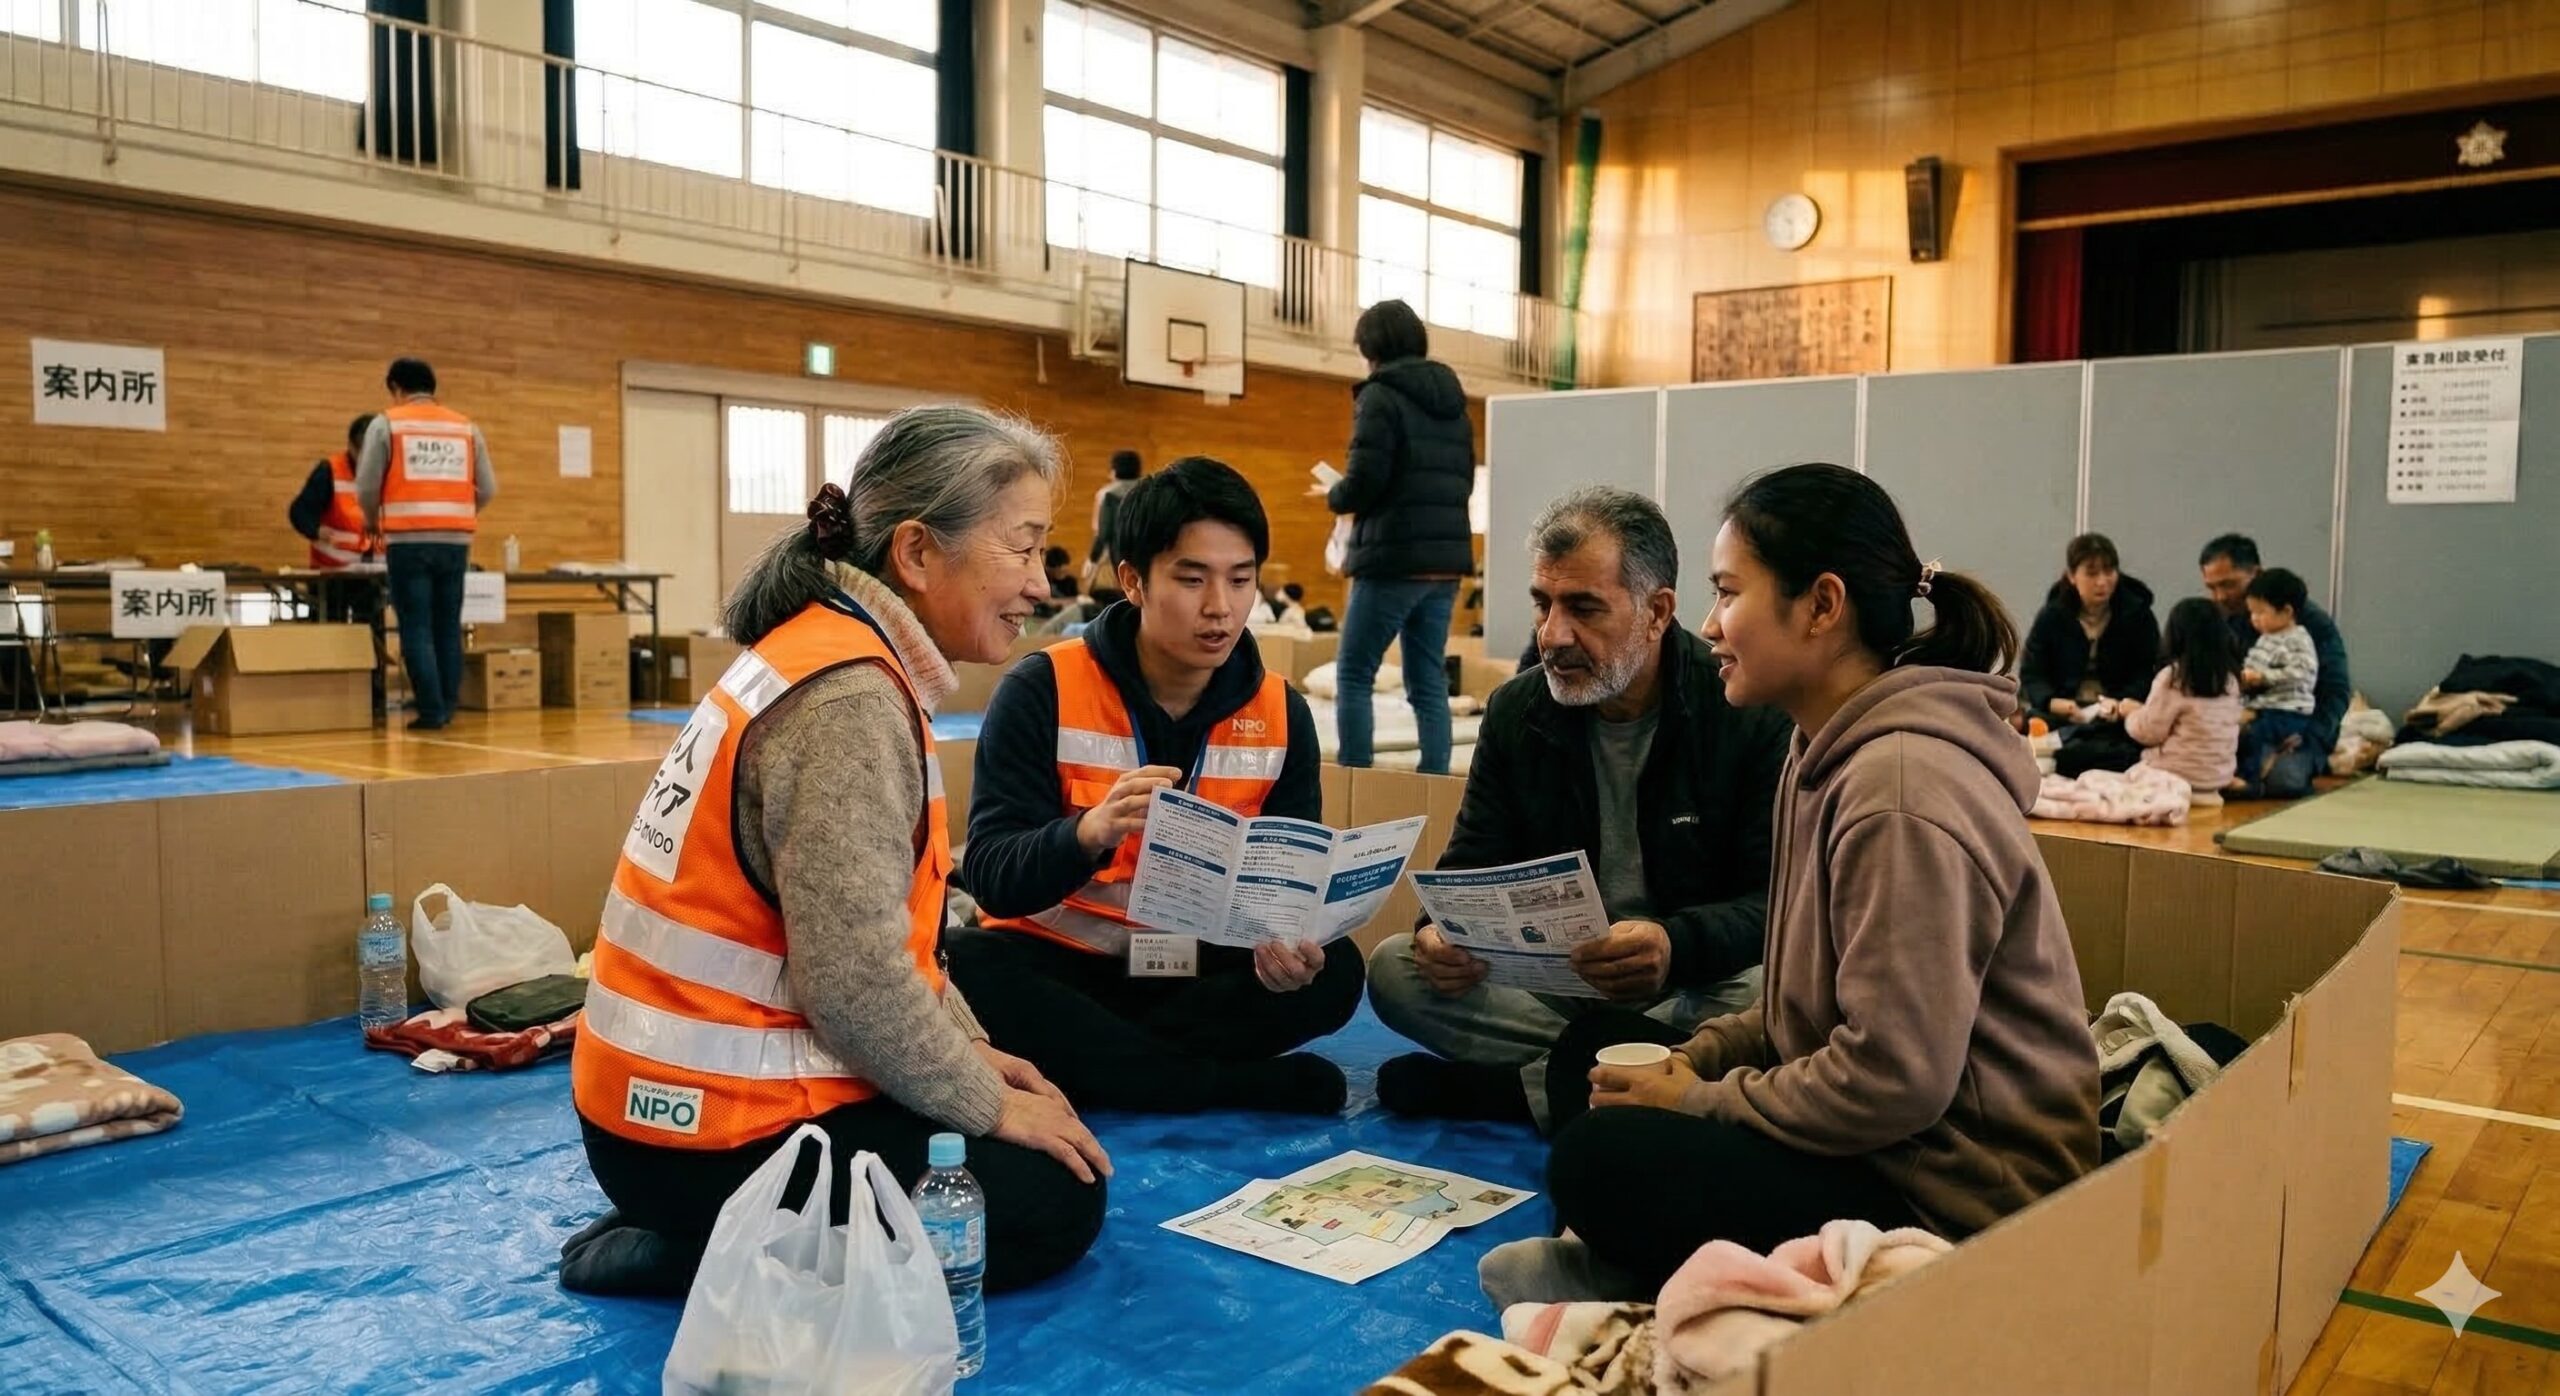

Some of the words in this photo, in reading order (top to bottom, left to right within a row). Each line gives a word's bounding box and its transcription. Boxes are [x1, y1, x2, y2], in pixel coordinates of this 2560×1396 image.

[43, 363, 157, 405] 案内所
[121, 588, 217, 619] 案内所
[1232, 719, 1266, 732] NPO
[630, 1092, 695, 1127] NPO
